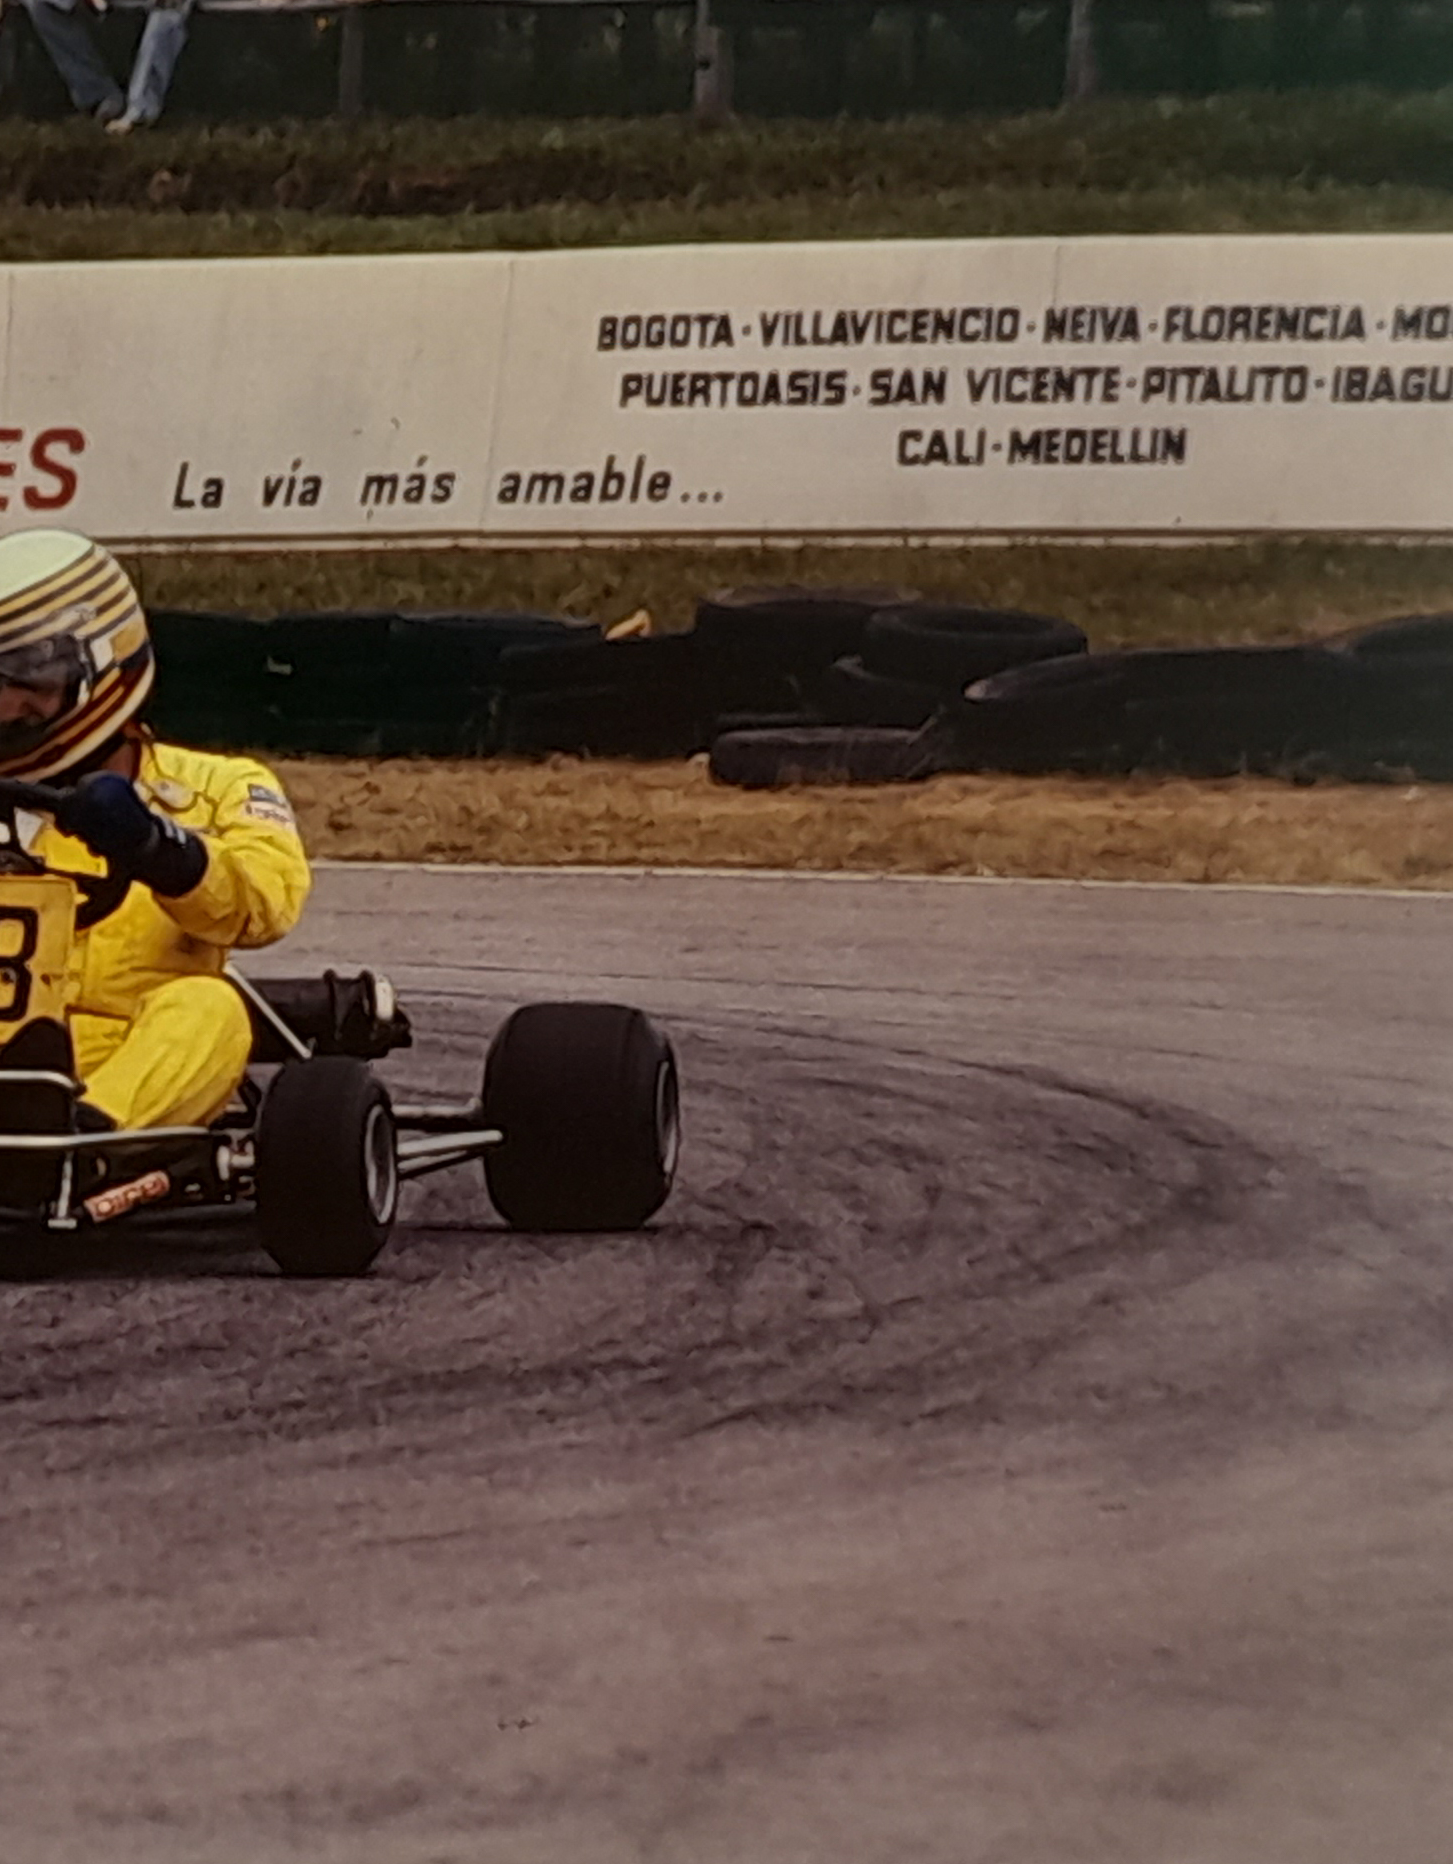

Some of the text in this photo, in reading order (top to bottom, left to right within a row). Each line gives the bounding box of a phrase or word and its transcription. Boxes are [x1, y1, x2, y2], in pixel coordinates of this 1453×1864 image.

[598, 305, 1453, 351] BOGOTA VILLAVICENCIO NEIVA FLORENCIA MO
[619, 370, 847, 407] PUERTOASIS
[868, 369, 946, 406] SAN
[967, 366, 1119, 404] VICENTE
[1141, 366, 1308, 403] PITALITO
[897, 427, 1186, 465] CALI MEDELLIN
[173, 454, 724, 508] La vía más amable...
